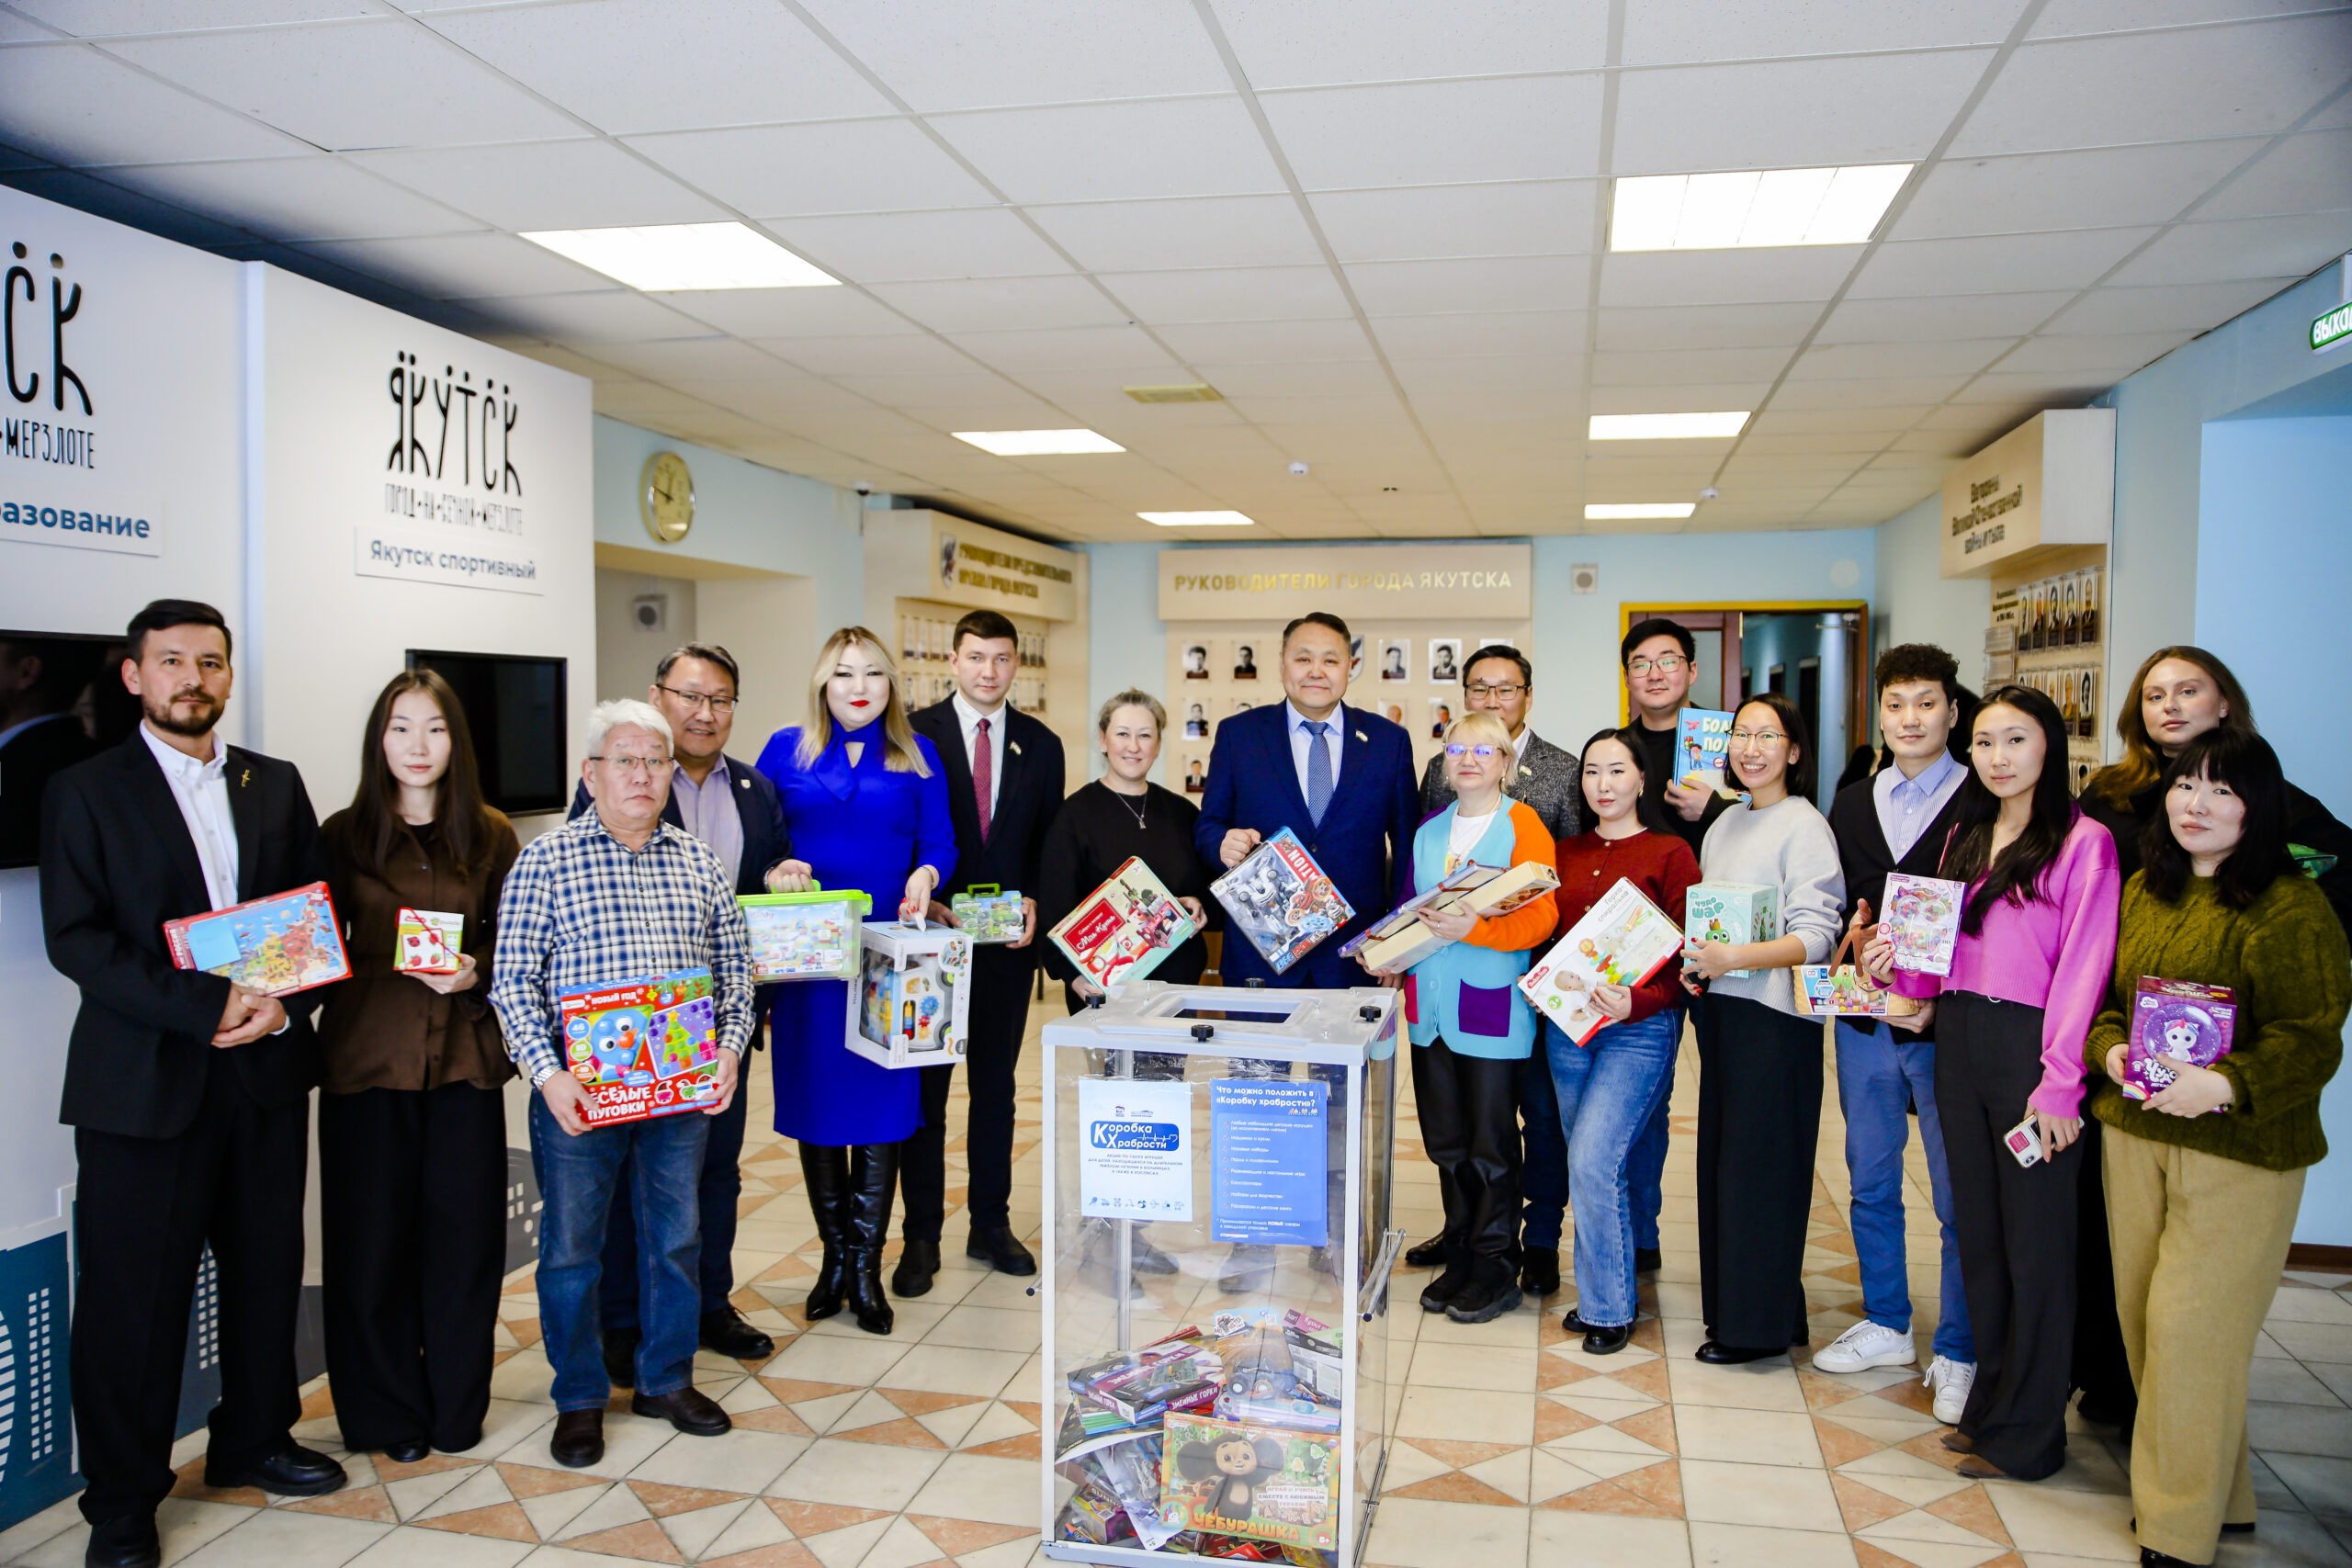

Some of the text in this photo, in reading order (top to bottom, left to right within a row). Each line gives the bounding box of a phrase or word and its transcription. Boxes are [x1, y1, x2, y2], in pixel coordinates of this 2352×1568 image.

[387, 350, 522, 497] ЯКУТСК
[6, 417, 95, 469] МЕРЗЛОТЕ
[0, 502, 150, 538] азование
[370, 539, 537, 581] Якутск спортивный
[1175, 570, 1511, 592] РУКОВОДИТЕЛИ ГОРОДА ЯКУТСКА
[591, 991, 638, 1005] НОВЫЙ ГОД
[1216, 1086, 1231, 1094] Что
[588, 1100, 646, 1121] ПУГОВКИ
[1216, 1096, 1316, 1108] «Коробку храбрости»?
[1093, 1122, 1153, 1144] Коробка
[1106, 1133, 1167, 1149] Храбрости
[1170, 1385, 1219, 1411] ЗМЕИНЫЕ ГОРКИ
[1194, 1513, 1301, 1541] ЧЕБУРАШКА
